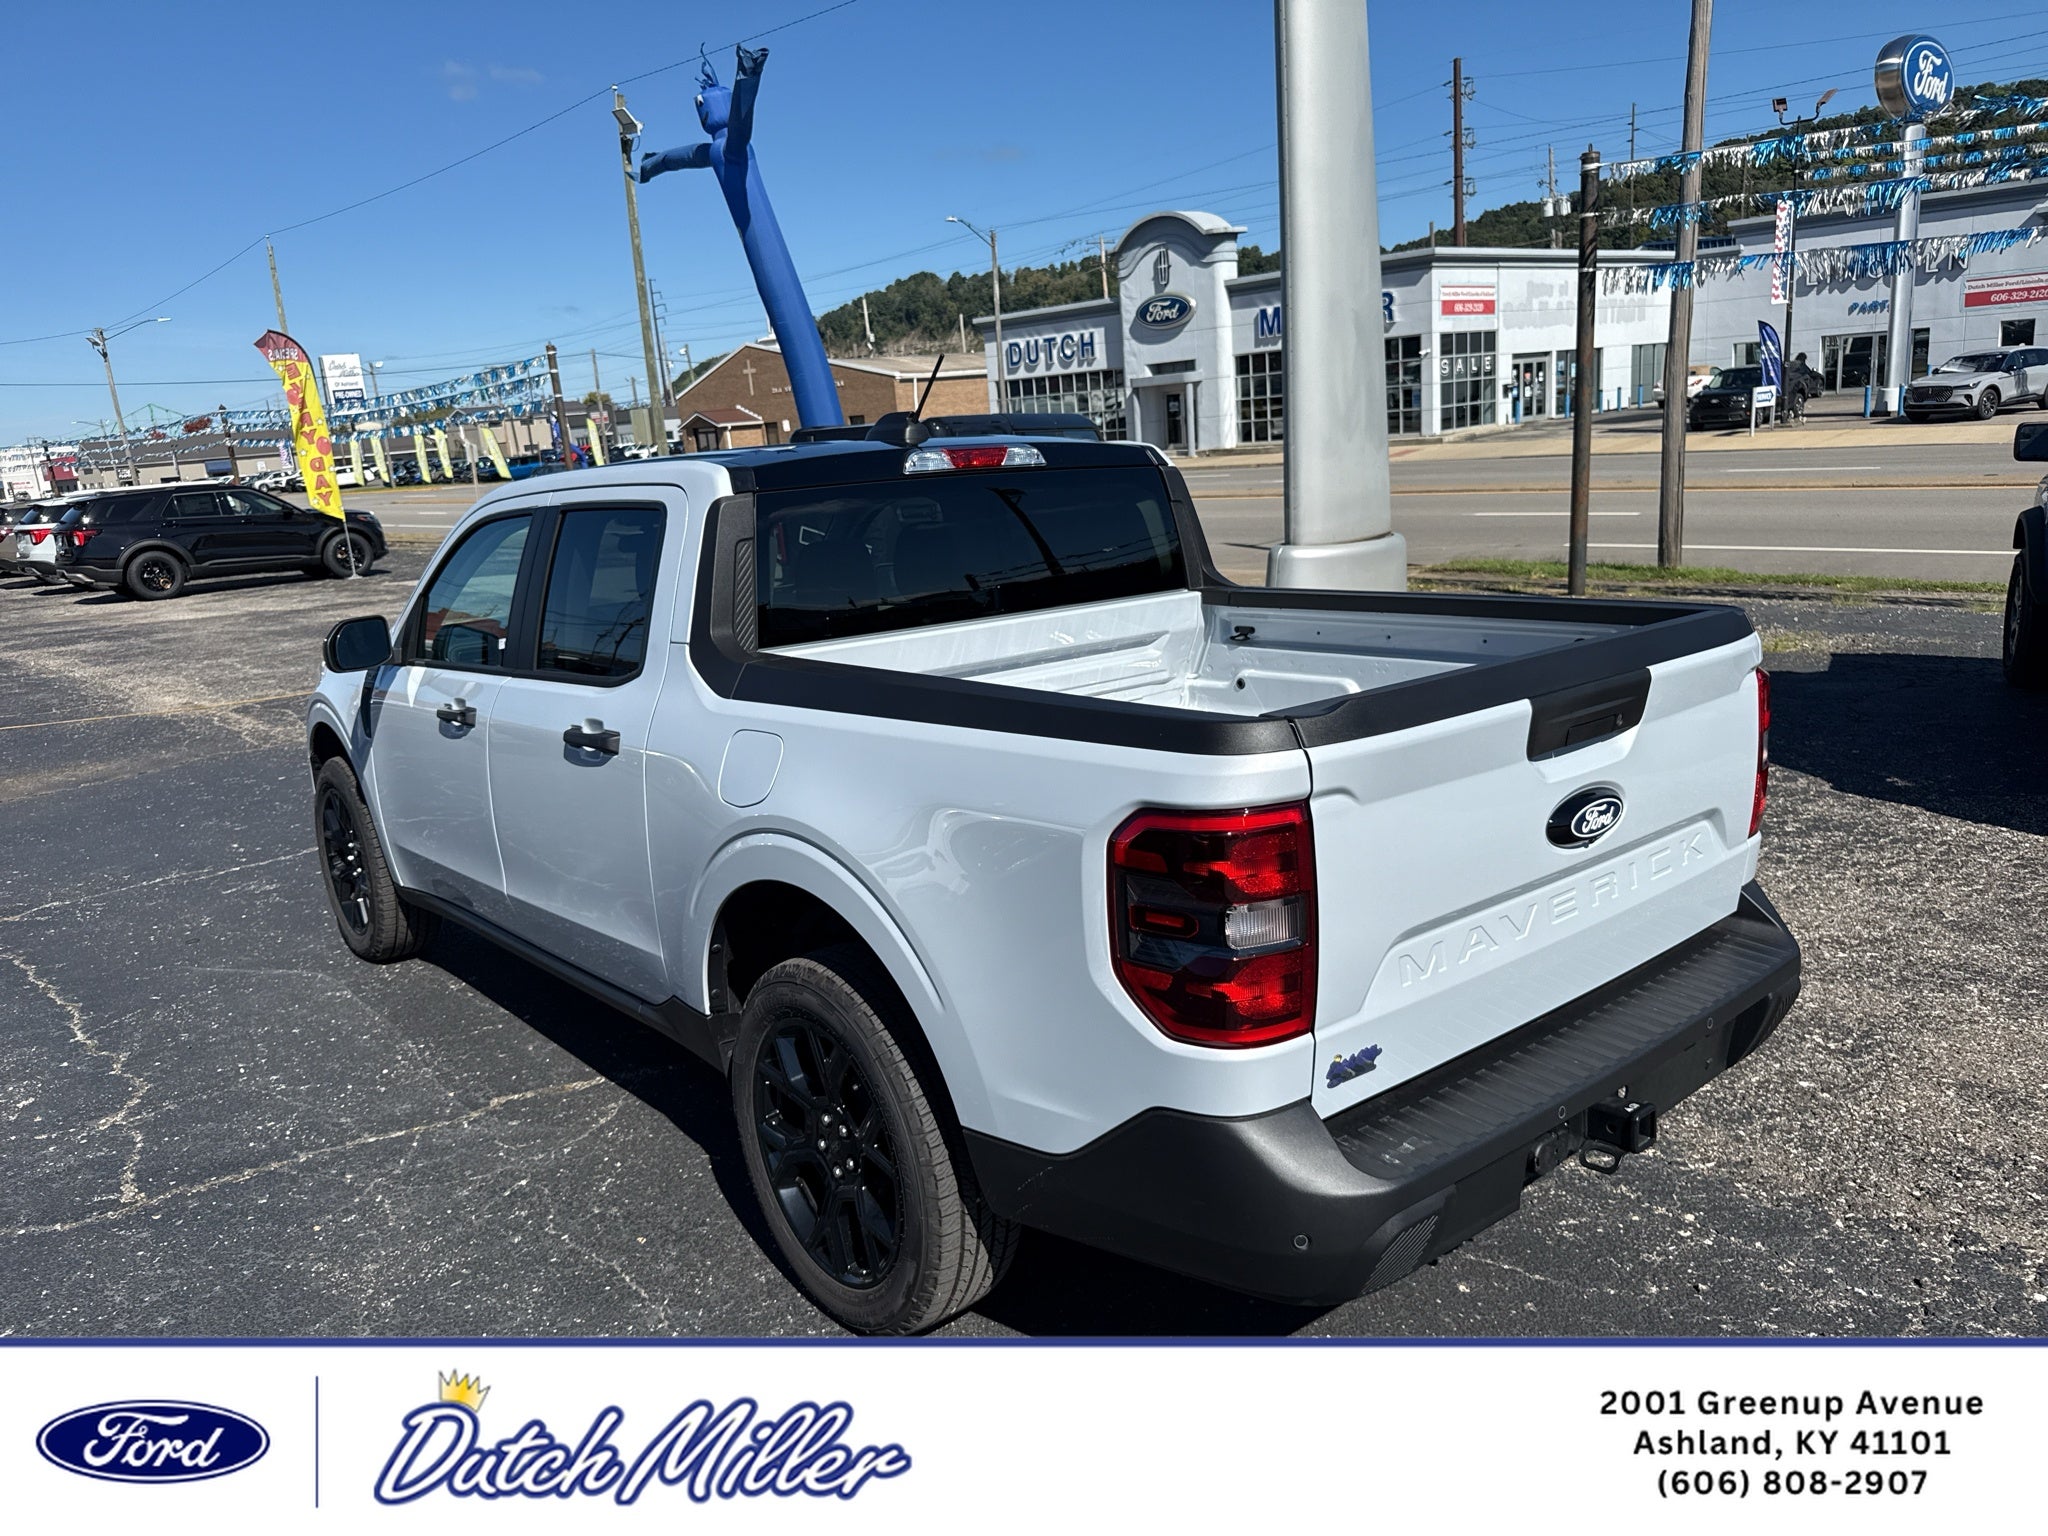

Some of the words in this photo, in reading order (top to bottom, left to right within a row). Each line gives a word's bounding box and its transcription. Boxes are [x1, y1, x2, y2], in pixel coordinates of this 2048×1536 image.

[1914, 50, 1949, 104] Ford
[1146, 301, 1180, 323] Ford
[1848, 300, 1890, 316] PART
[1008, 331, 1096, 369] DUTCH
[1440, 356, 1492, 376] SALE
[1581, 803, 1615, 834] Ford
[1399, 831, 1705, 988] MAVERICK
